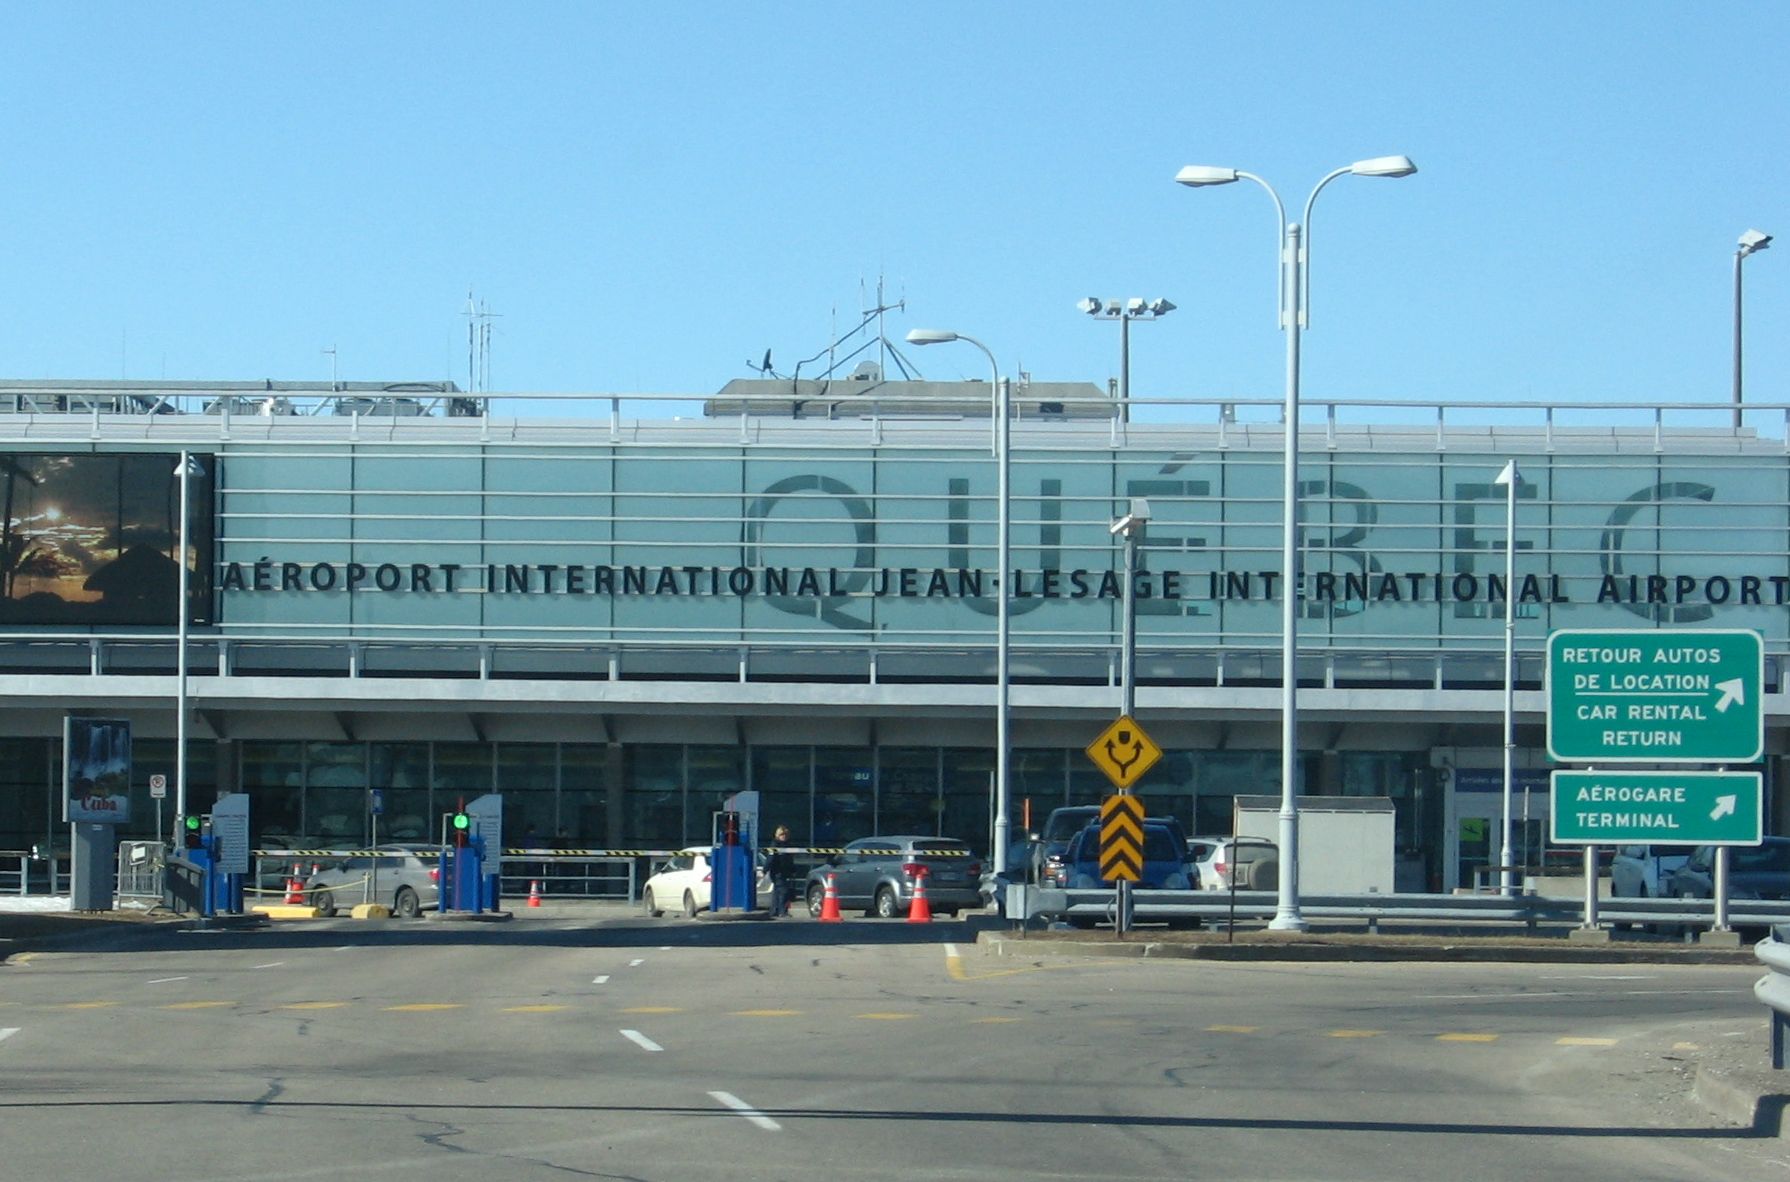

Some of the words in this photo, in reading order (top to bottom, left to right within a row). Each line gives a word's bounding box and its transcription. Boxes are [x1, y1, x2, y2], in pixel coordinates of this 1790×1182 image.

[744, 454, 1715, 631] QUÉBEC
[222, 556, 460, 592] AÉROPORT
[488, 564, 848, 596] INTERNATIONAL
[1597, 574, 1789, 606] AIRPORT
[1563, 649, 1641, 663] RETOUR
[1653, 649, 1720, 663] AUTOS
[1575, 675, 1600, 689] DE
[1611, 675, 1709, 689] LOCATION
[1577, 705, 1617, 720] CAR
[1629, 706, 1706, 720] RENTAL
[1603, 731, 1681, 745] RETURN
[1576, 785, 1685, 802] AÉROGARE
[81, 795, 117, 811] Cuba
[1576, 813, 1679, 828] TERMINAL
